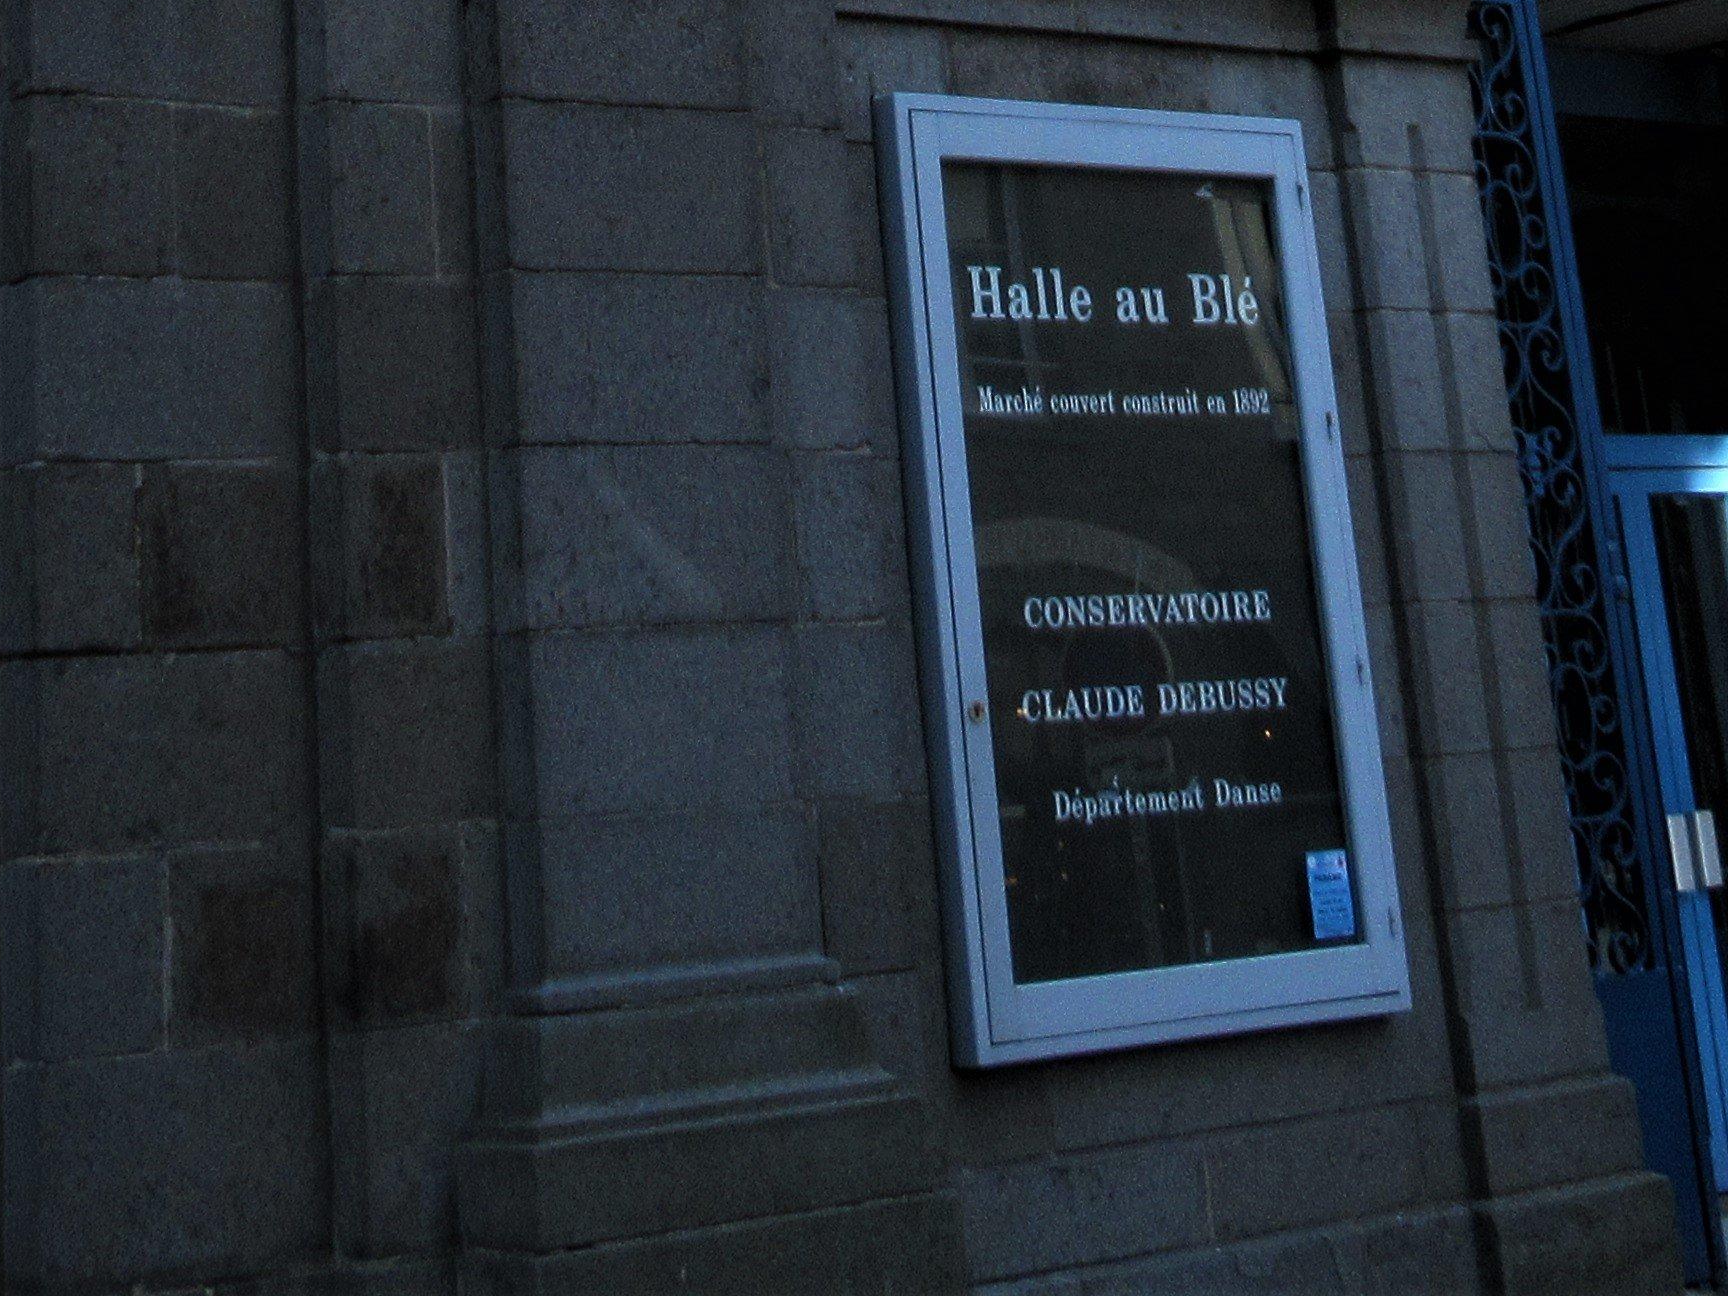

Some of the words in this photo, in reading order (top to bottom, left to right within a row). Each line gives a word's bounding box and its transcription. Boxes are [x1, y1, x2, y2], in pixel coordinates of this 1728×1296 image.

[967, 264, 1092, 322] Halle
[1115, 285, 1170, 323] au
[1187, 272, 1259, 326] Blé
[977, 384, 1044, 414] Marché
[1050, 389, 1115, 414] couvert
[1122, 386, 1200, 414] construit
[1206, 397, 1227, 414] en
[1232, 386, 1271, 414] 1892
[1024, 590, 1271, 628] CONSERVATOIRE
[1023, 685, 1145, 722] CLAUDE
[1158, 677, 1287, 715] DEBUSSY
[1053, 785, 1204, 824] Département
[1212, 777, 1284, 808] Danse
